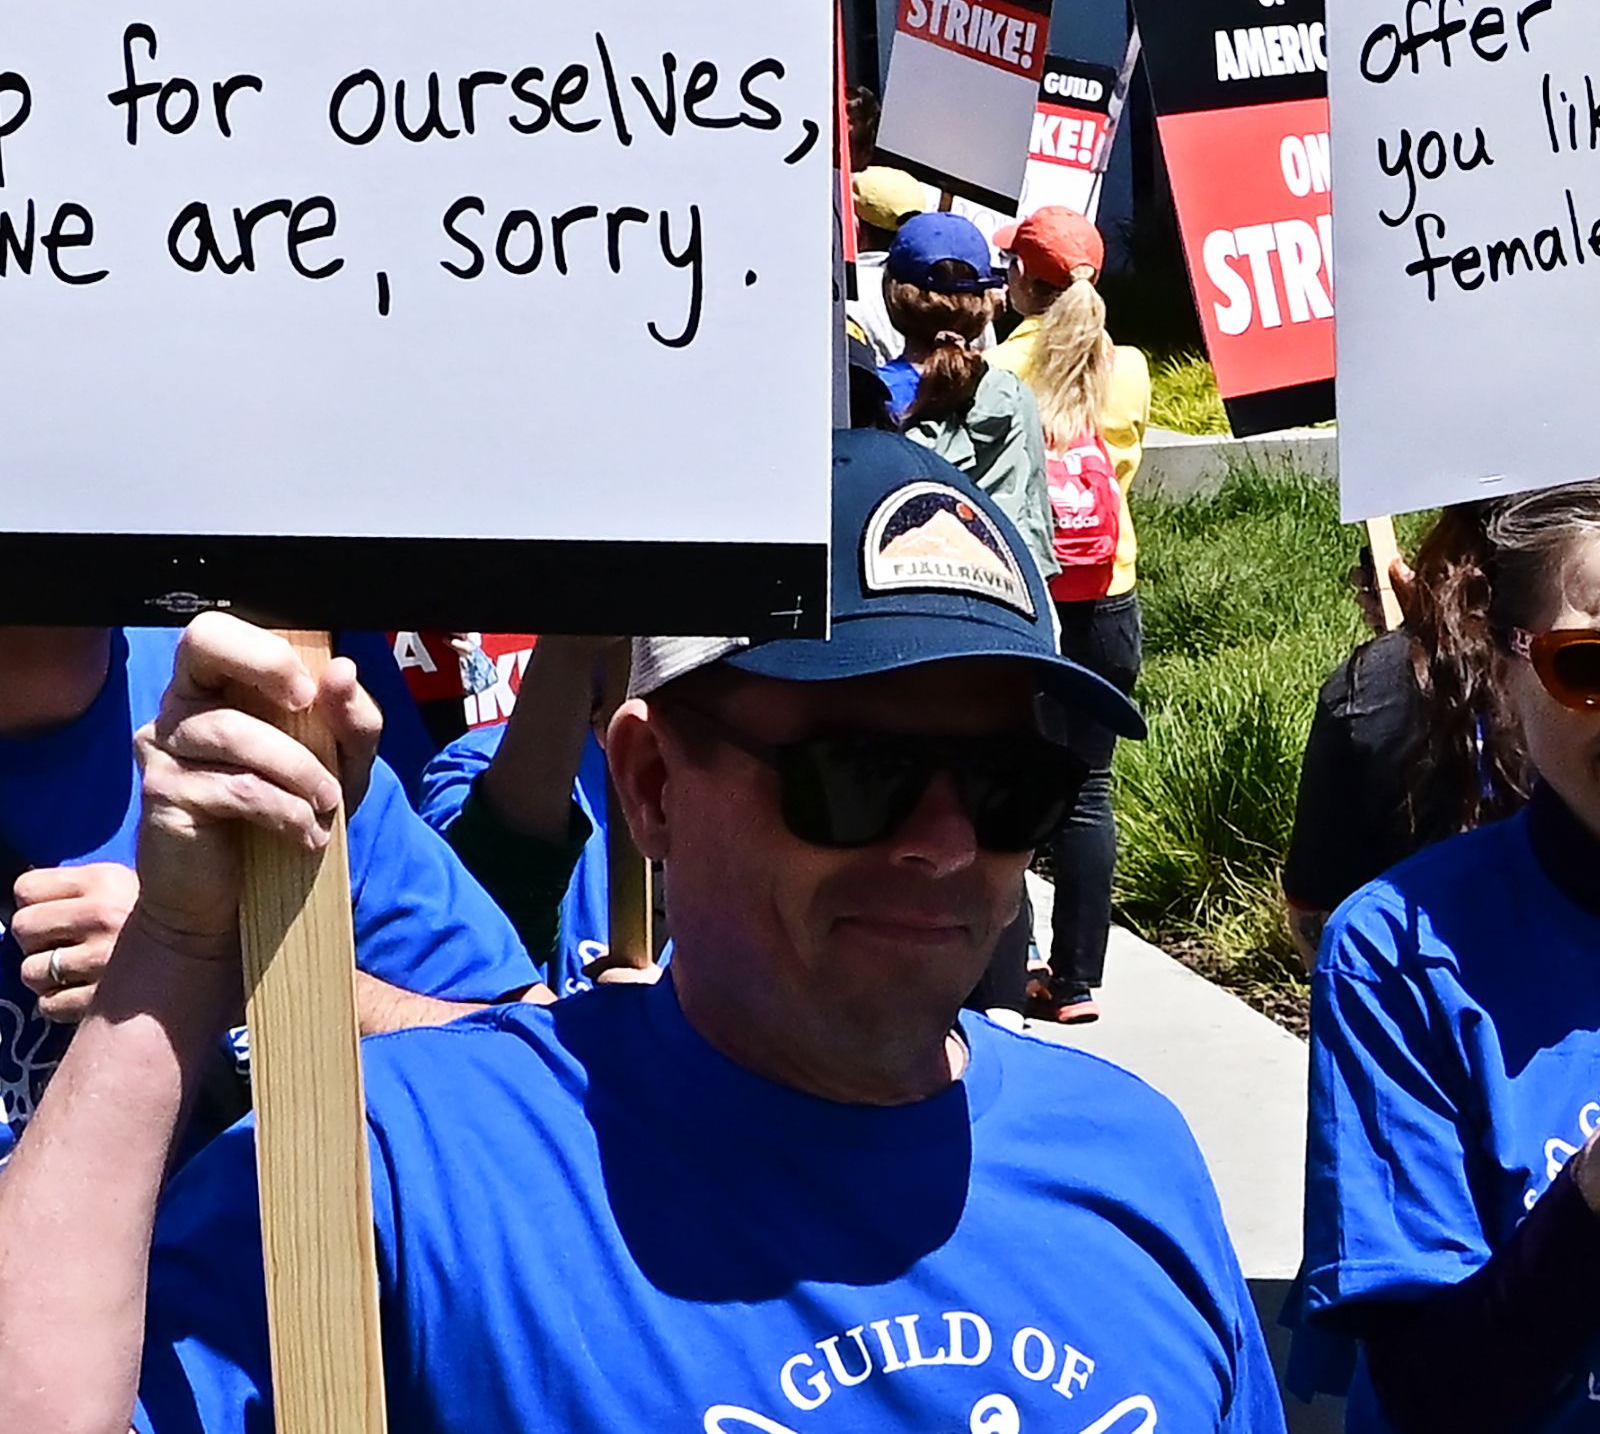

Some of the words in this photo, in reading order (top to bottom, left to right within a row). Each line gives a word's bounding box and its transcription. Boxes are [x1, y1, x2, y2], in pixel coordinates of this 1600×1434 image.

[107, 22, 263, 146] for
[329, 32, 820, 165] ourselves,
[1043, 72, 1103, 103] GUILD
[1214, 21, 1329, 82] AMERIC
[1377, 127, 1495, 229] you
[167, 195, 390, 316] are,
[440, 196, 758, 349] sorry.
[780, 1310, 994, 1412] GUILD
[1010, 1326, 1096, 1400] OF
